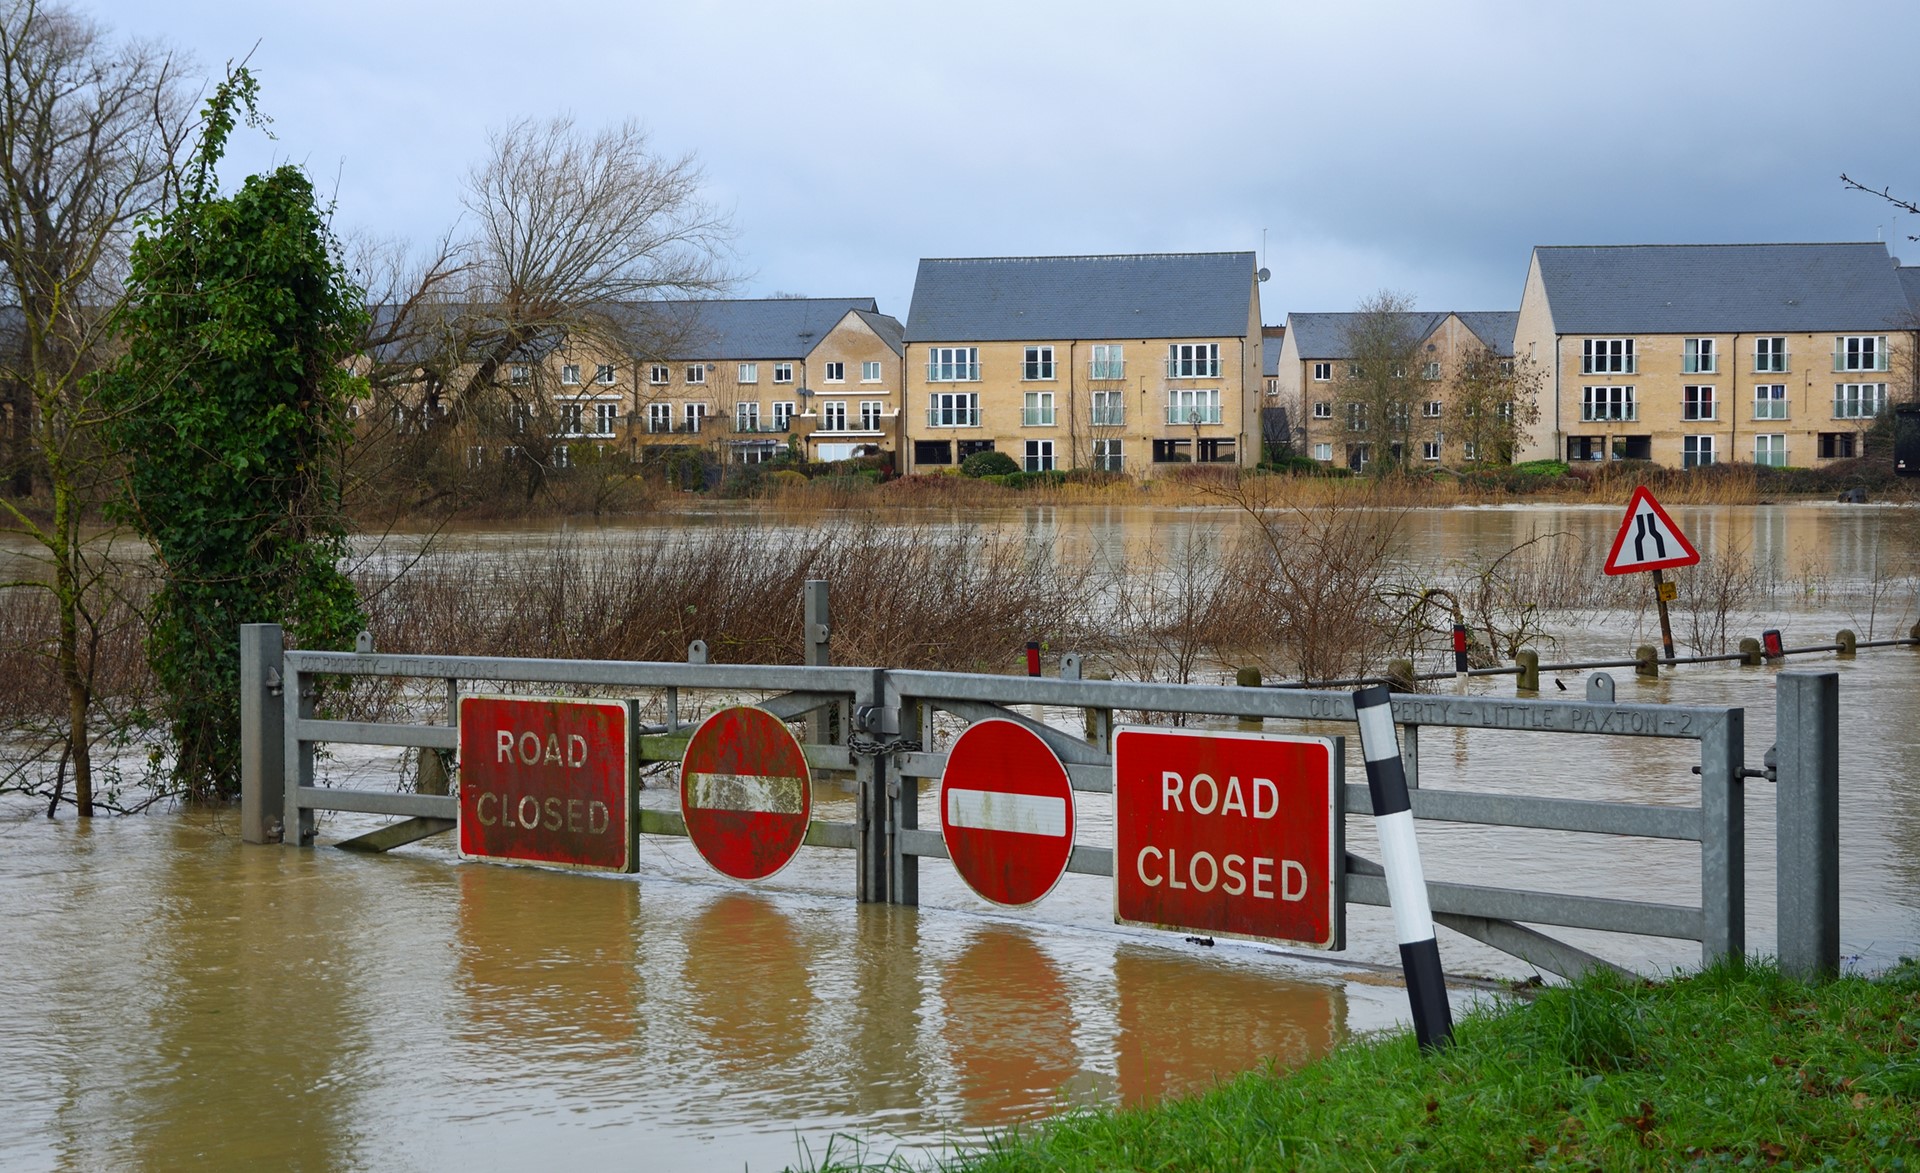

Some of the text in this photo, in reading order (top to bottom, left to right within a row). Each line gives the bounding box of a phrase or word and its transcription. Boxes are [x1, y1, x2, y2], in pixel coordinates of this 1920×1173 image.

[323, 657, 380, 674] PROPERTY
[391, 659, 435, 676] LITTLE
[1310, 697, 1344, 717] CCC
[1482, 705, 1554, 728] LITTLE
[497, 729, 588, 768] ROAD
[477, 791, 610, 834] CLOSED
[1162, 771, 1279, 819] ROAD
[1137, 845, 1308, 902] CLOSED
